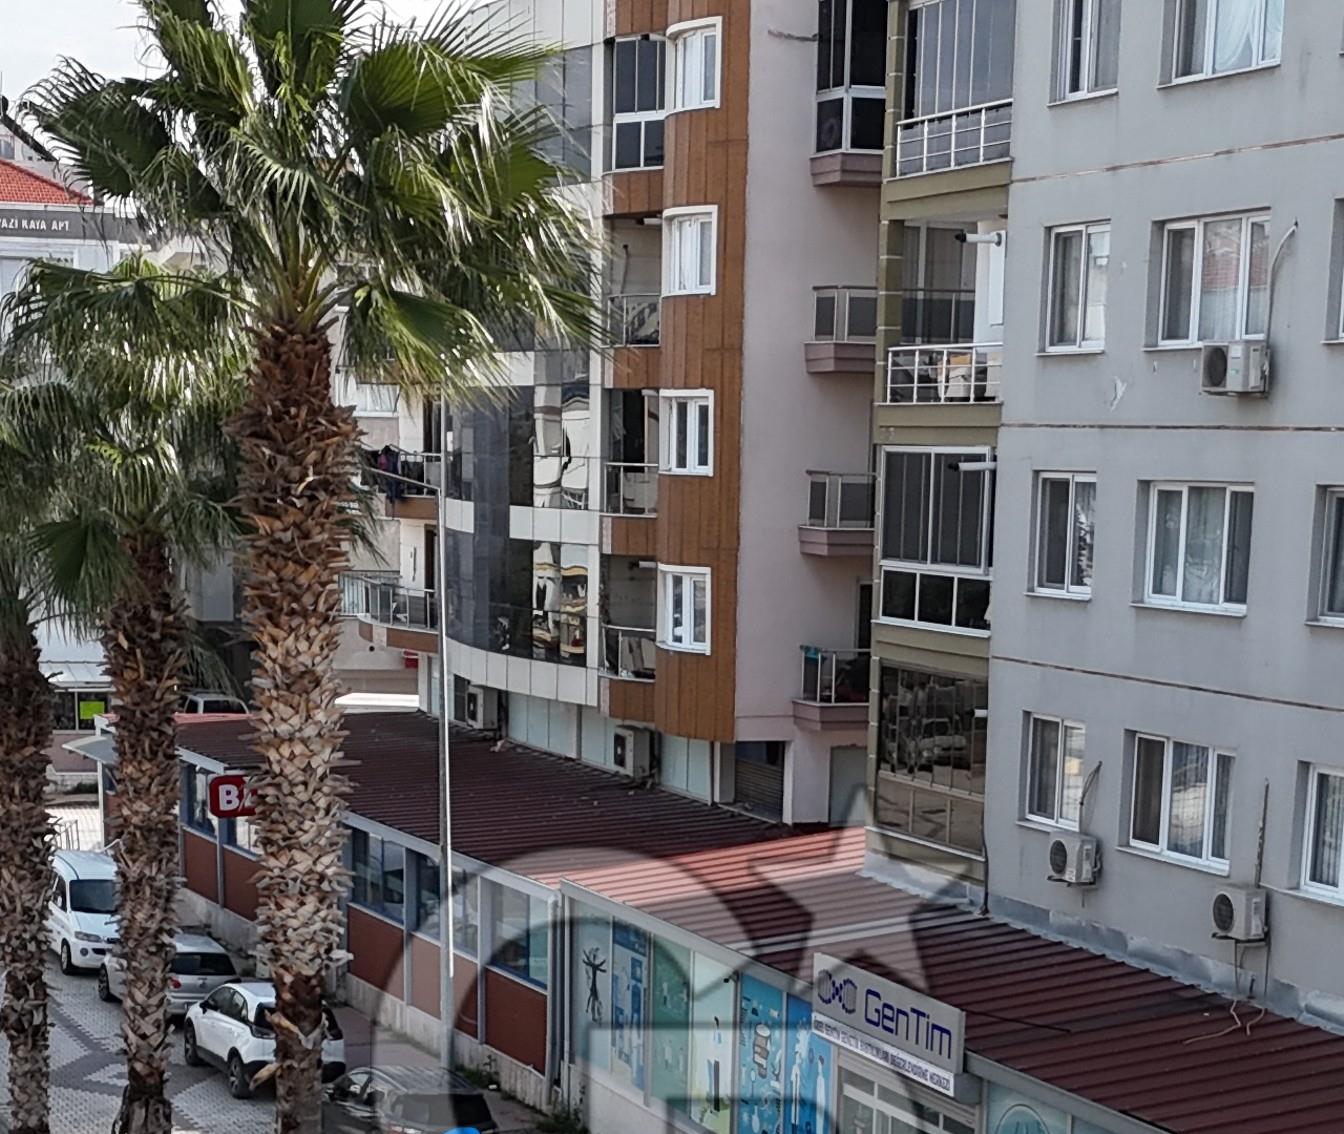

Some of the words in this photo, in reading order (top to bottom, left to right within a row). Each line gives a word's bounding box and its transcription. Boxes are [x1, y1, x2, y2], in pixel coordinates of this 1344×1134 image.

[21, 218, 47, 231] KAYA
[51, 219, 70, 232] APT
[864, 988, 952, 1060] GenTim
